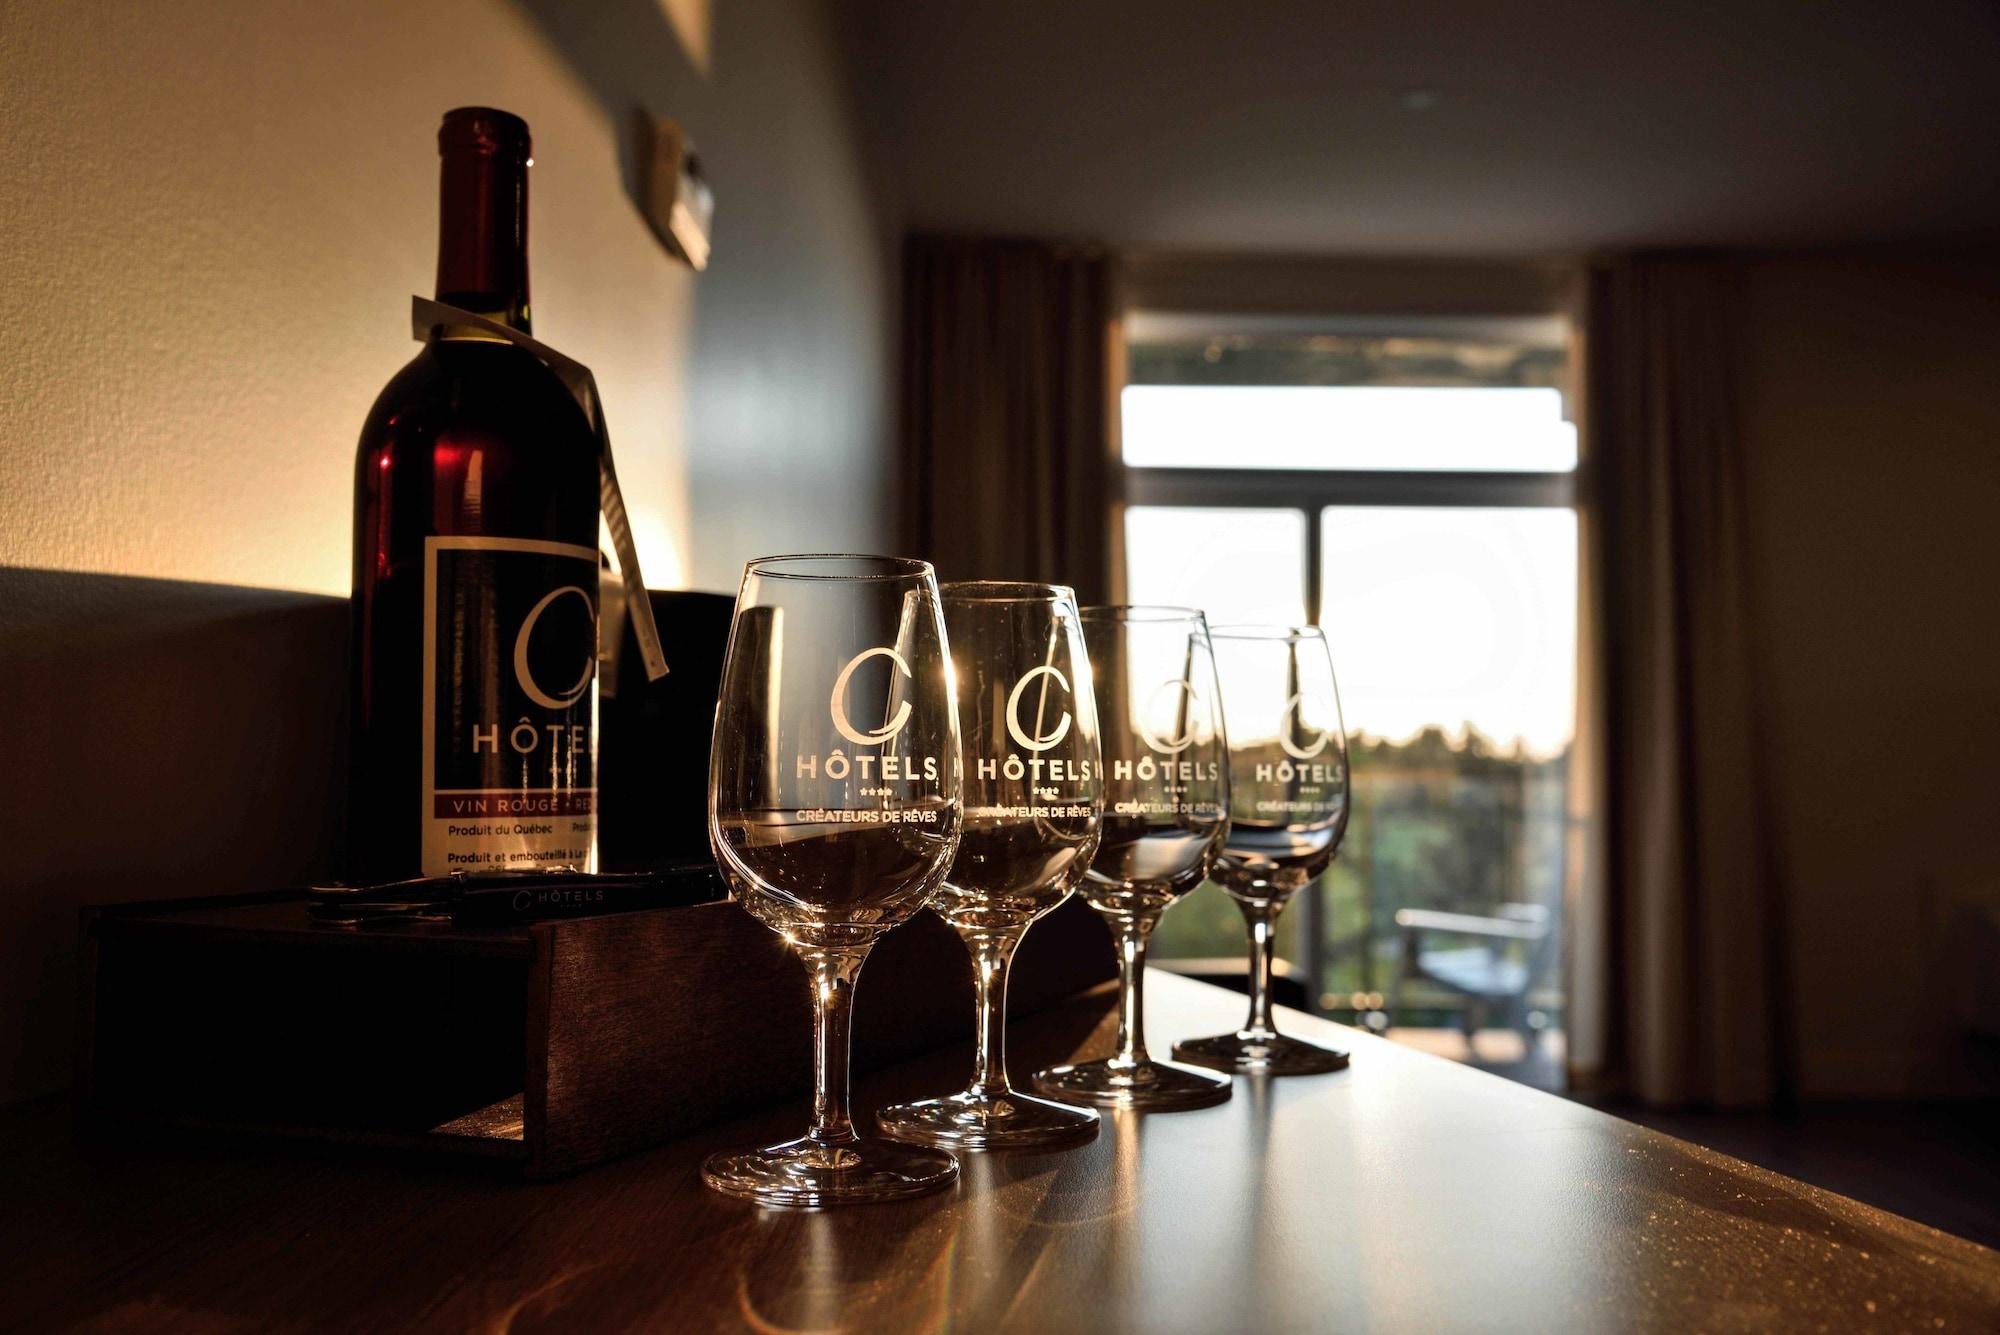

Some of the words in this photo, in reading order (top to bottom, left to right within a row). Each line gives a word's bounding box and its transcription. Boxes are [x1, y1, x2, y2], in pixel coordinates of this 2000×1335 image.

[830, 647, 912, 745] C
[1006, 666, 1071, 751] C
[796, 749, 938, 781] HÔTELS
[978, 754, 1091, 781] HÔTELS
[1114, 755, 1218, 781] HÔTELS
[1256, 760, 1343, 783] HÔTELS
[453, 799, 488, 813] VIN
[497, 799, 560, 813] ROUGE
[1051, 807, 1065, 818] DE
[1066, 804, 1091, 818] RÊVES
[1180, 803, 1194, 814] DE
[796, 808, 879, 823] CRÉATEURS
[882, 811, 900, 823] DE
[903, 808, 937, 823] RÊVES
[448, 825, 492, 836] Produit
[496, 825, 510, 835] du
[514, 823, 553, 835] Québec
[447, 852, 491, 863] Produit
[494, 852, 506, 862] et
[538, 889, 604, 904] HÔTELS
